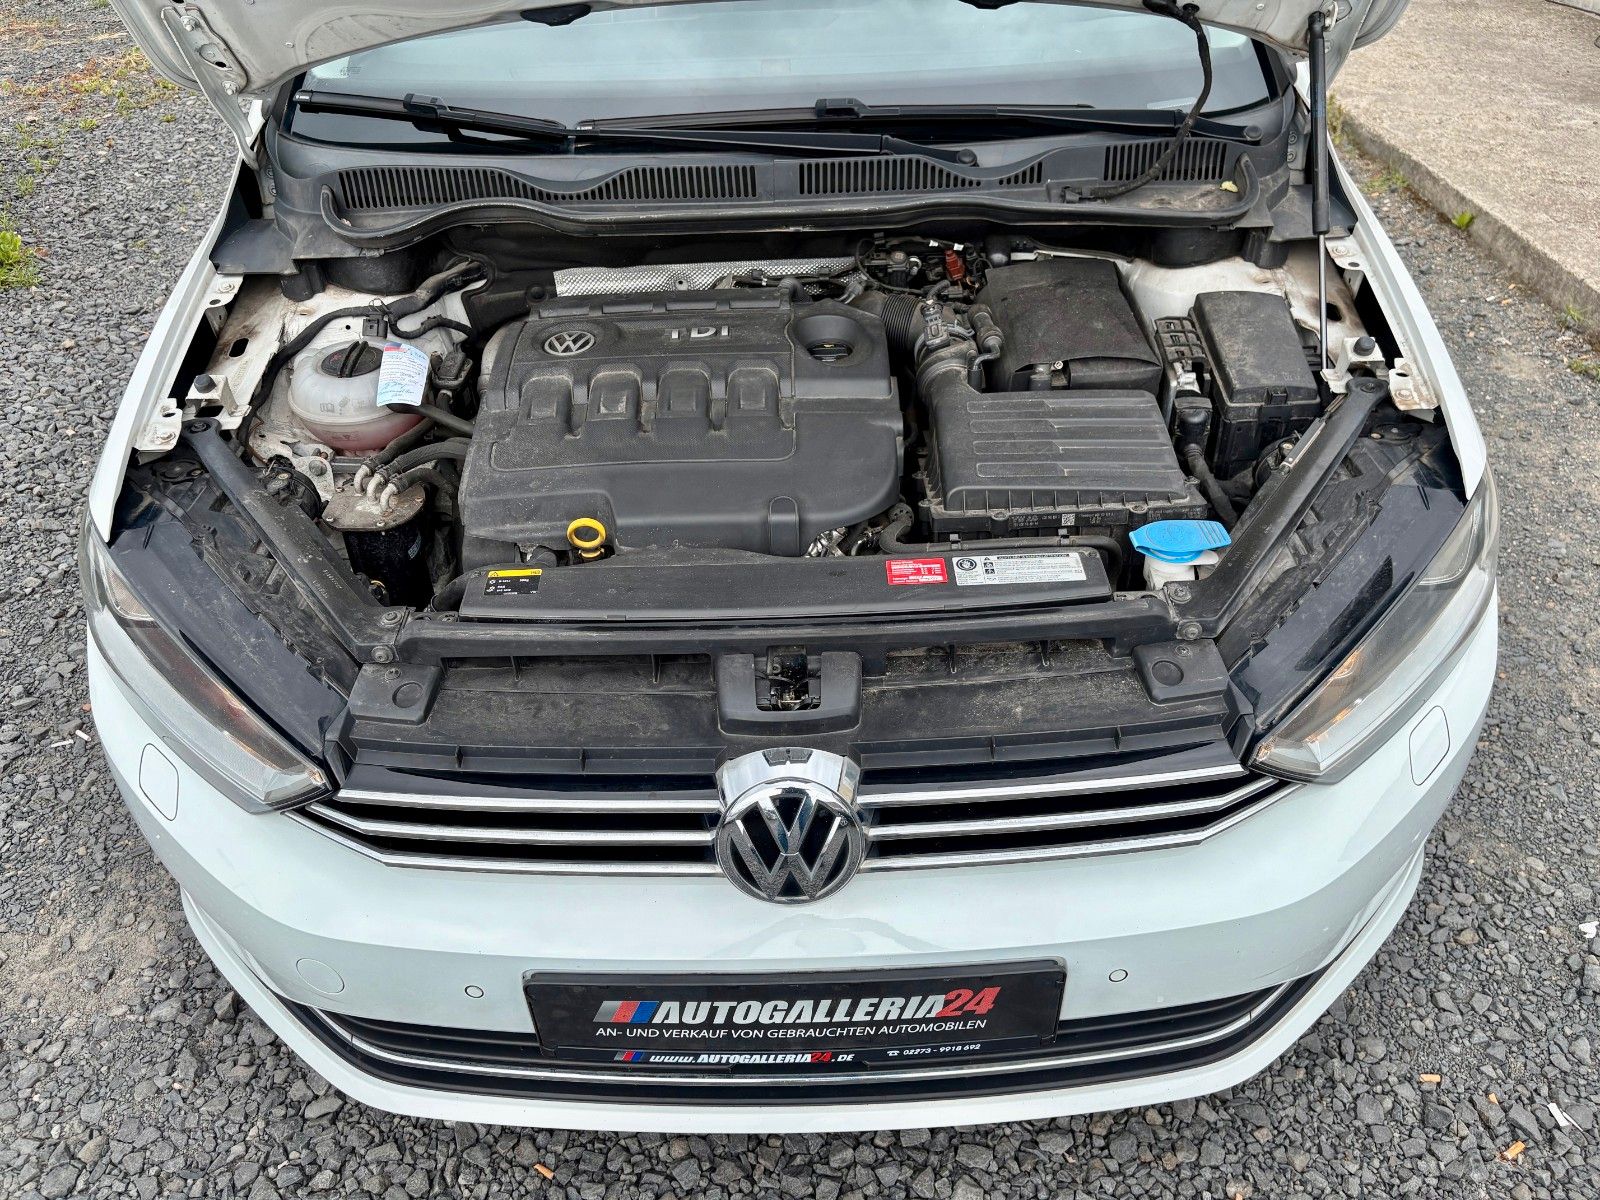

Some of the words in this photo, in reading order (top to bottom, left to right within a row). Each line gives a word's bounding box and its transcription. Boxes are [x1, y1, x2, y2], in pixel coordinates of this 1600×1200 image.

[545, 331, 595, 355] VW
[665, 325, 729, 340] TDI
[716, 779, 863, 903] VW
[651, 986, 1001, 1025] AUTOGALLERIA24
[595, 1027, 623, 1037] AN-
[626, 1028, 660, 1038] UND
[662, 1029, 728, 1039] VERKAUF
[731, 1029, 764, 1039] VON
[767, 1026, 876, 1039] GEBRAUCHTEN
[878, 1019, 987, 1035] AUTOMOBILEN
[903, 1048, 932, 1056] 02273
[939, 1045, 962, 1054] 9918
[963, 1043, 981, 1051] 692
